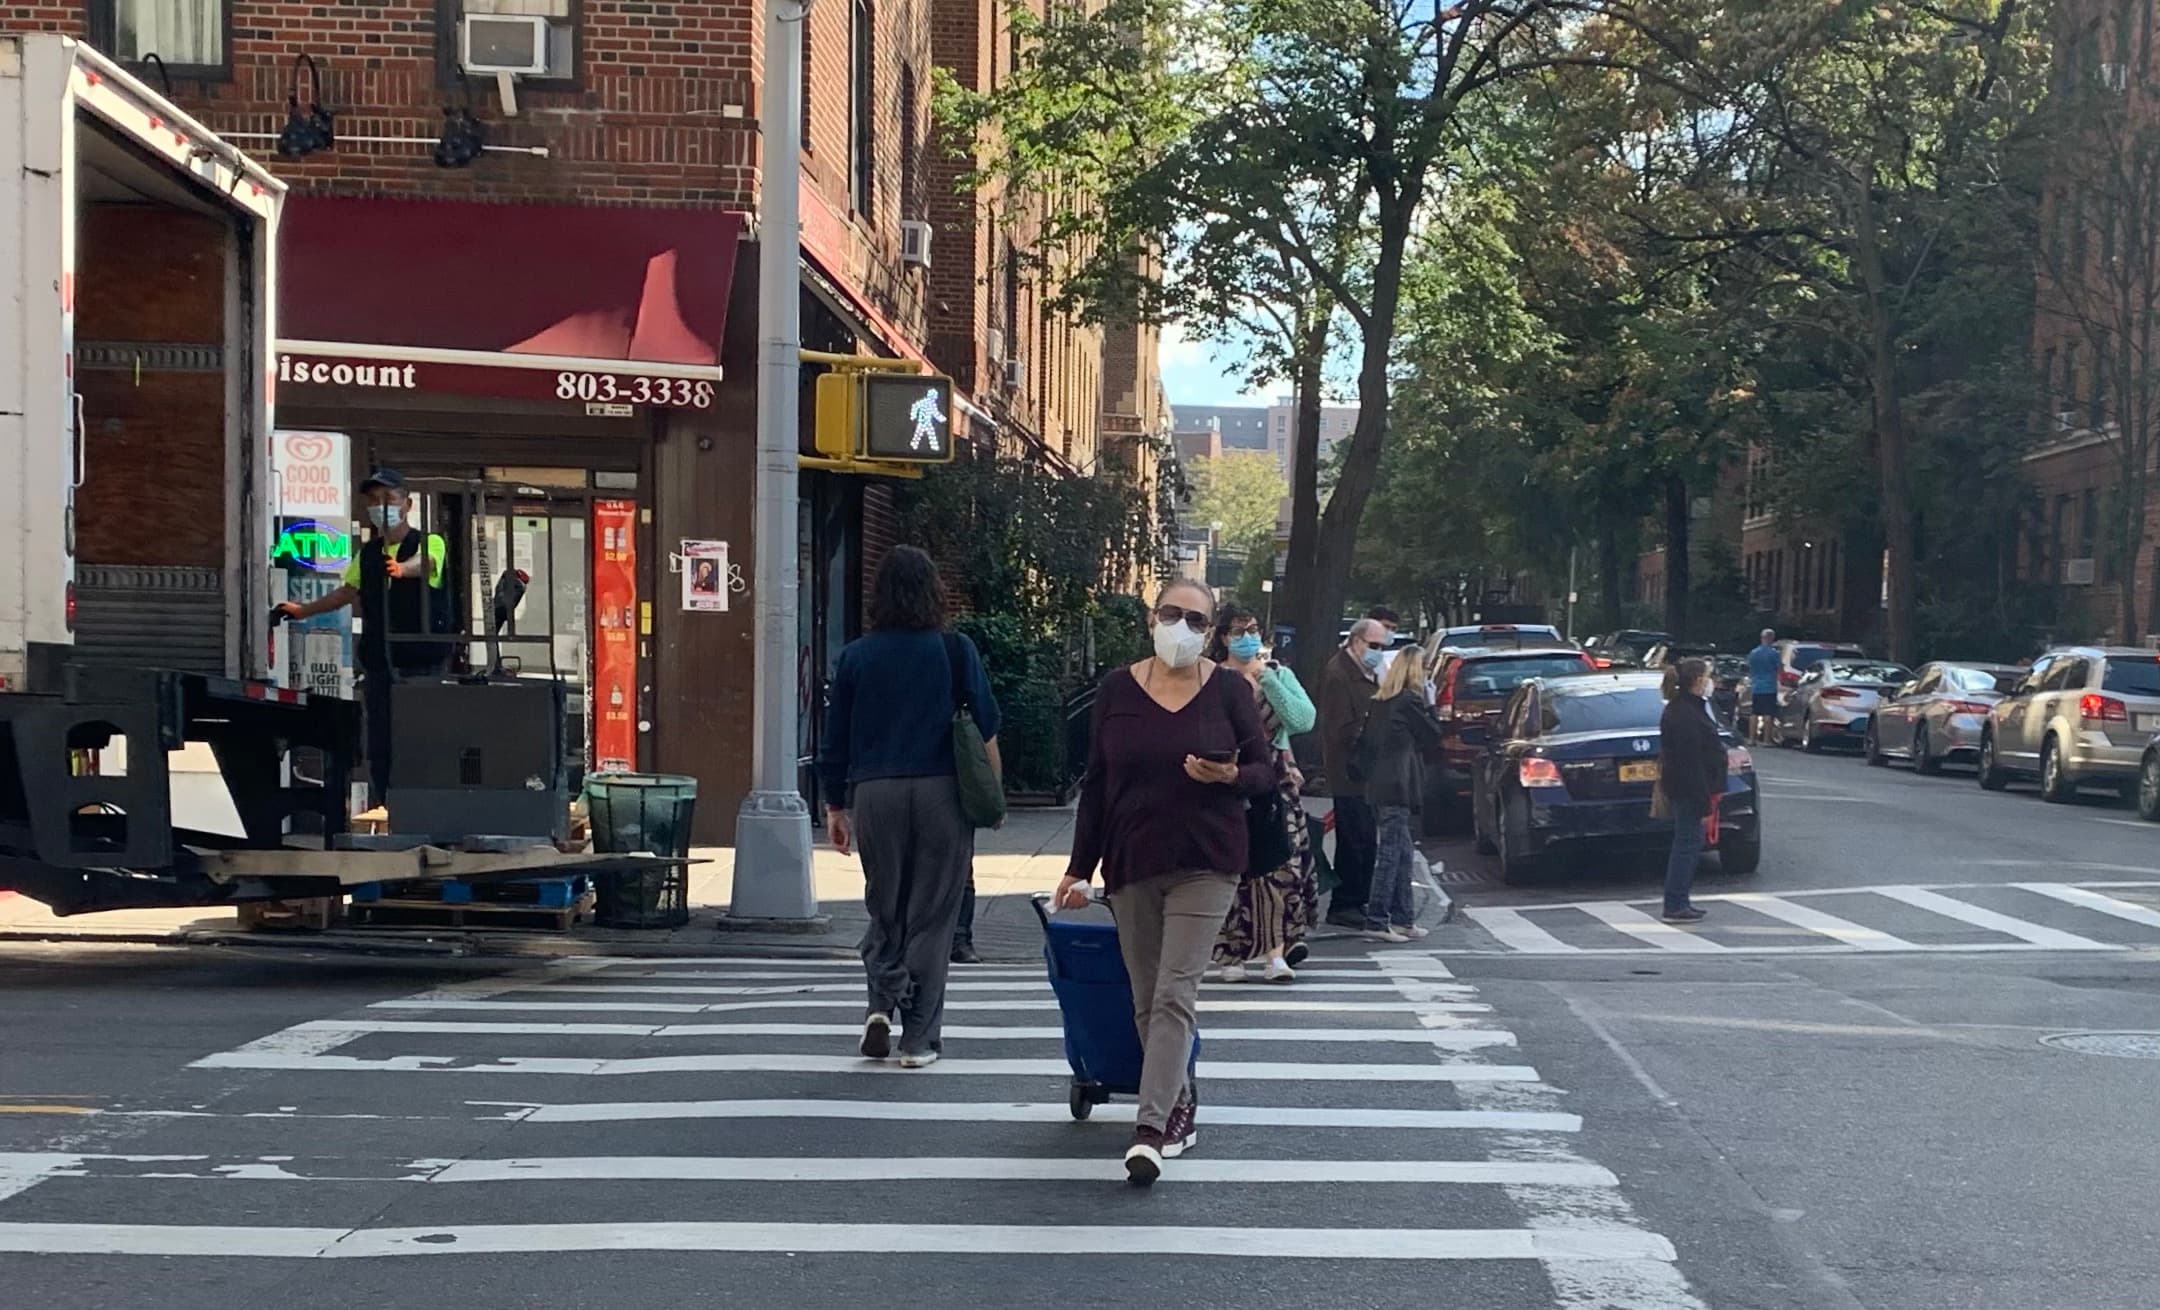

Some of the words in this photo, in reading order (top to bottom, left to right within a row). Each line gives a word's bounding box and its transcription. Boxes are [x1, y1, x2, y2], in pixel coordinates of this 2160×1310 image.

[275, 355, 416, 388] iscount
[555, 371, 715, 409] 803-3338
[286, 464, 331, 484] GOOD
[281, 486, 339, 504] HUMOR
[273, 532, 349, 558] ATM
[310, 662, 338, 674] BUD
[306, 673, 342, 686] LIGHT
